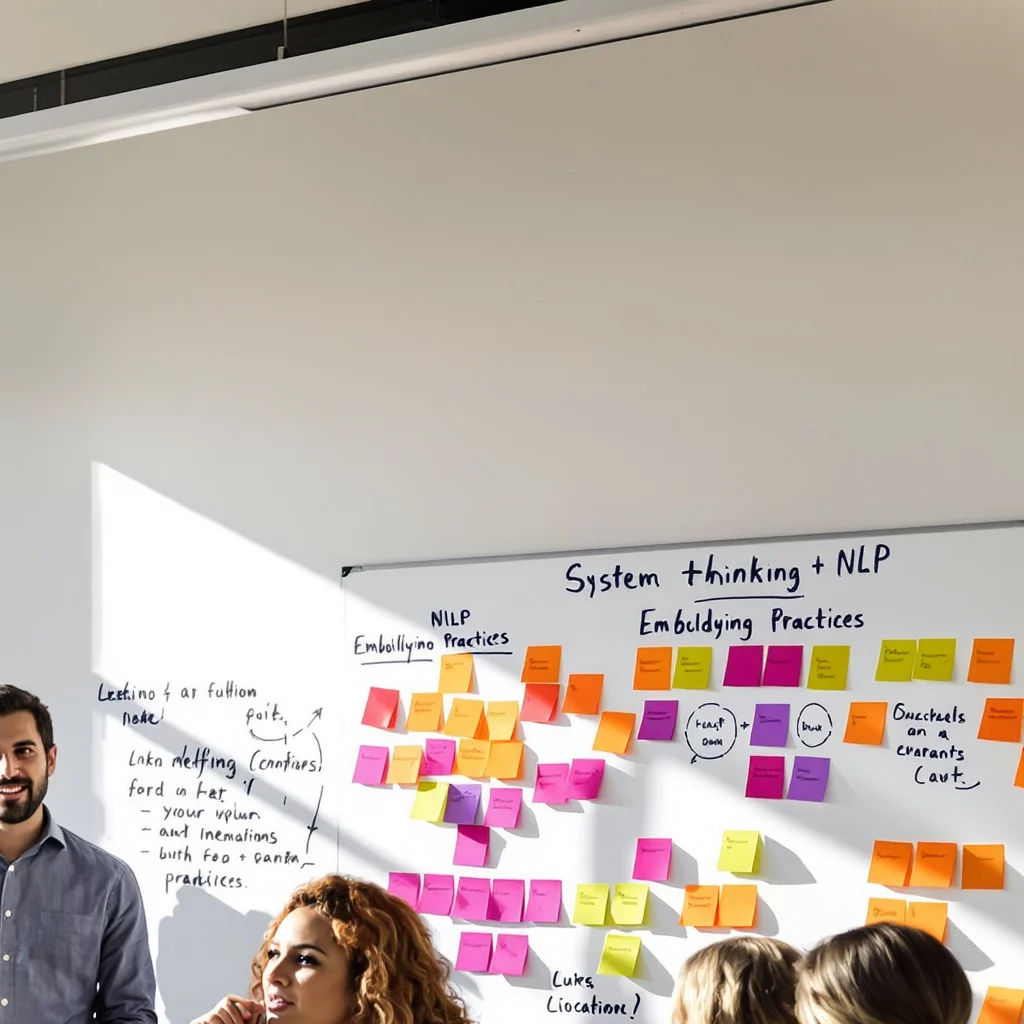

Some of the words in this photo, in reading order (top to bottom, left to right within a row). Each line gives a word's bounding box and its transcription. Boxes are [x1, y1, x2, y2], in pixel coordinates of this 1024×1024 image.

[565, 562, 660, 598] System
[681, 554, 801, 593] thinking
[837, 544, 891, 578] NLP
[771, 608, 865, 633] Practices
